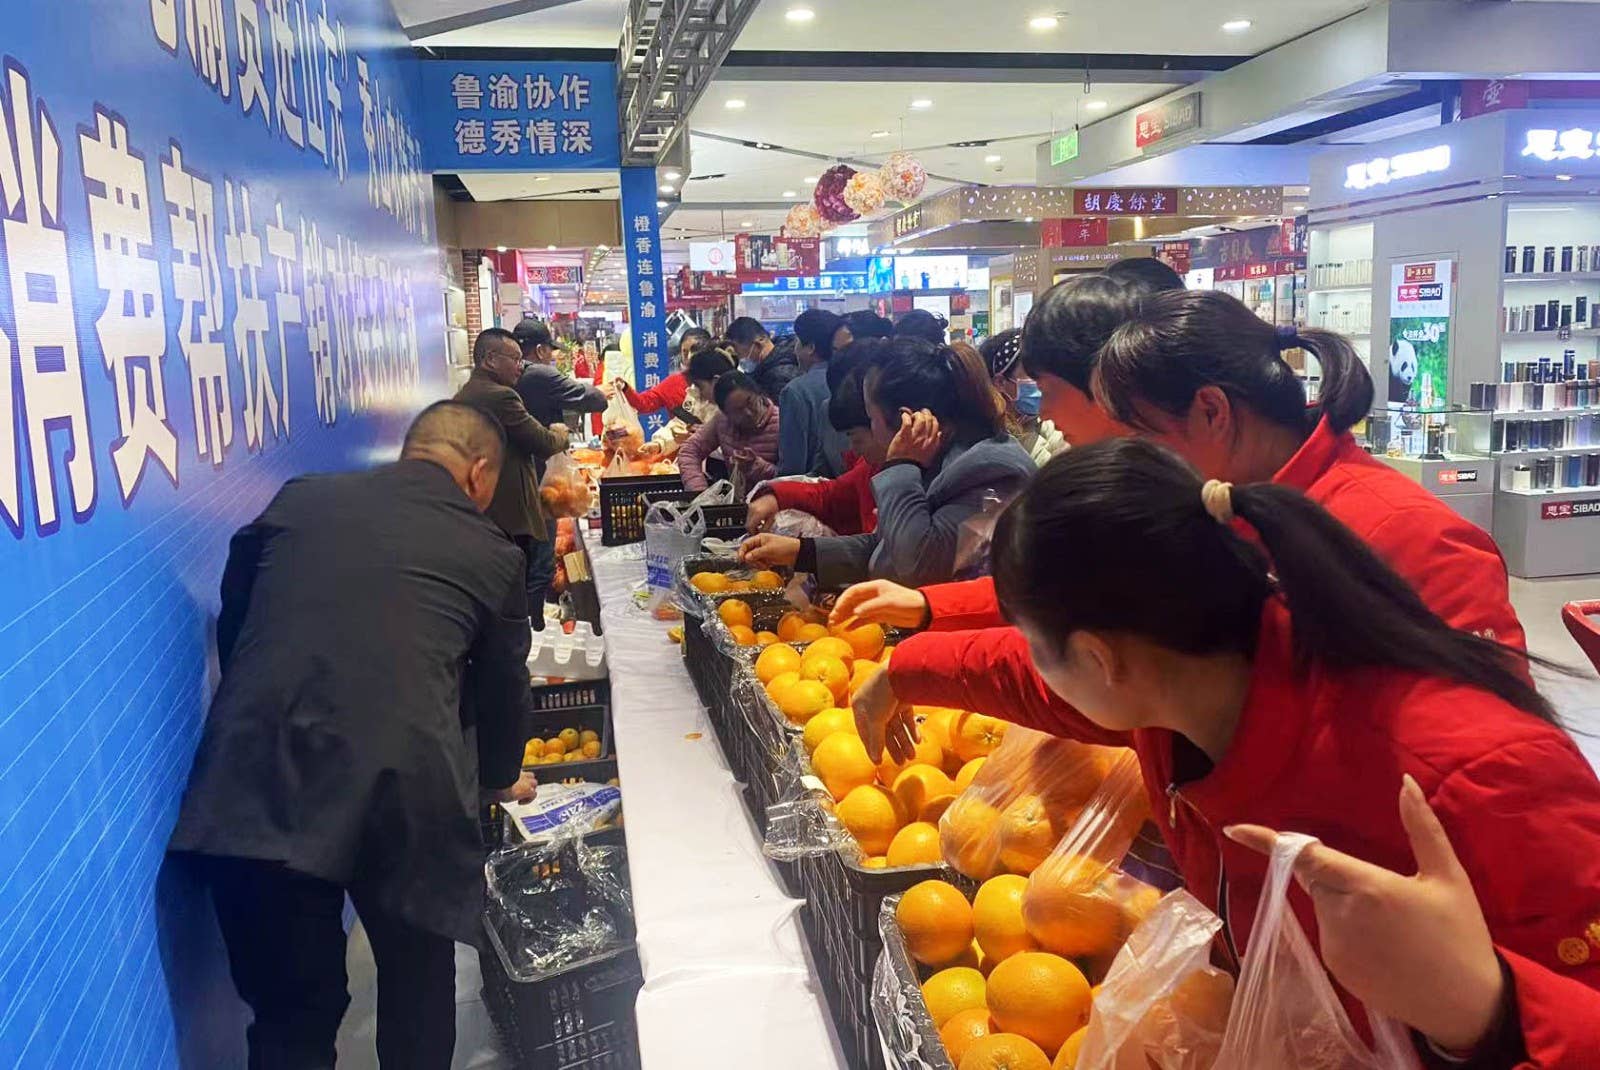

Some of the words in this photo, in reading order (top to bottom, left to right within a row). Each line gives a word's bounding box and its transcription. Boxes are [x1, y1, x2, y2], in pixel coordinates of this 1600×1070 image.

[451, 73, 591, 111] 鲁渝协作
[454, 119, 593, 155] 德秀情深
[633, 215, 656, 319] 橙香连鲁渝
[1418, 287, 1441, 298] SIBAO
[642, 331, 664, 430] 消费助兴
[1456, 472, 1476, 481] SIBAO
[1572, 503, 1600, 514] SIBAO
